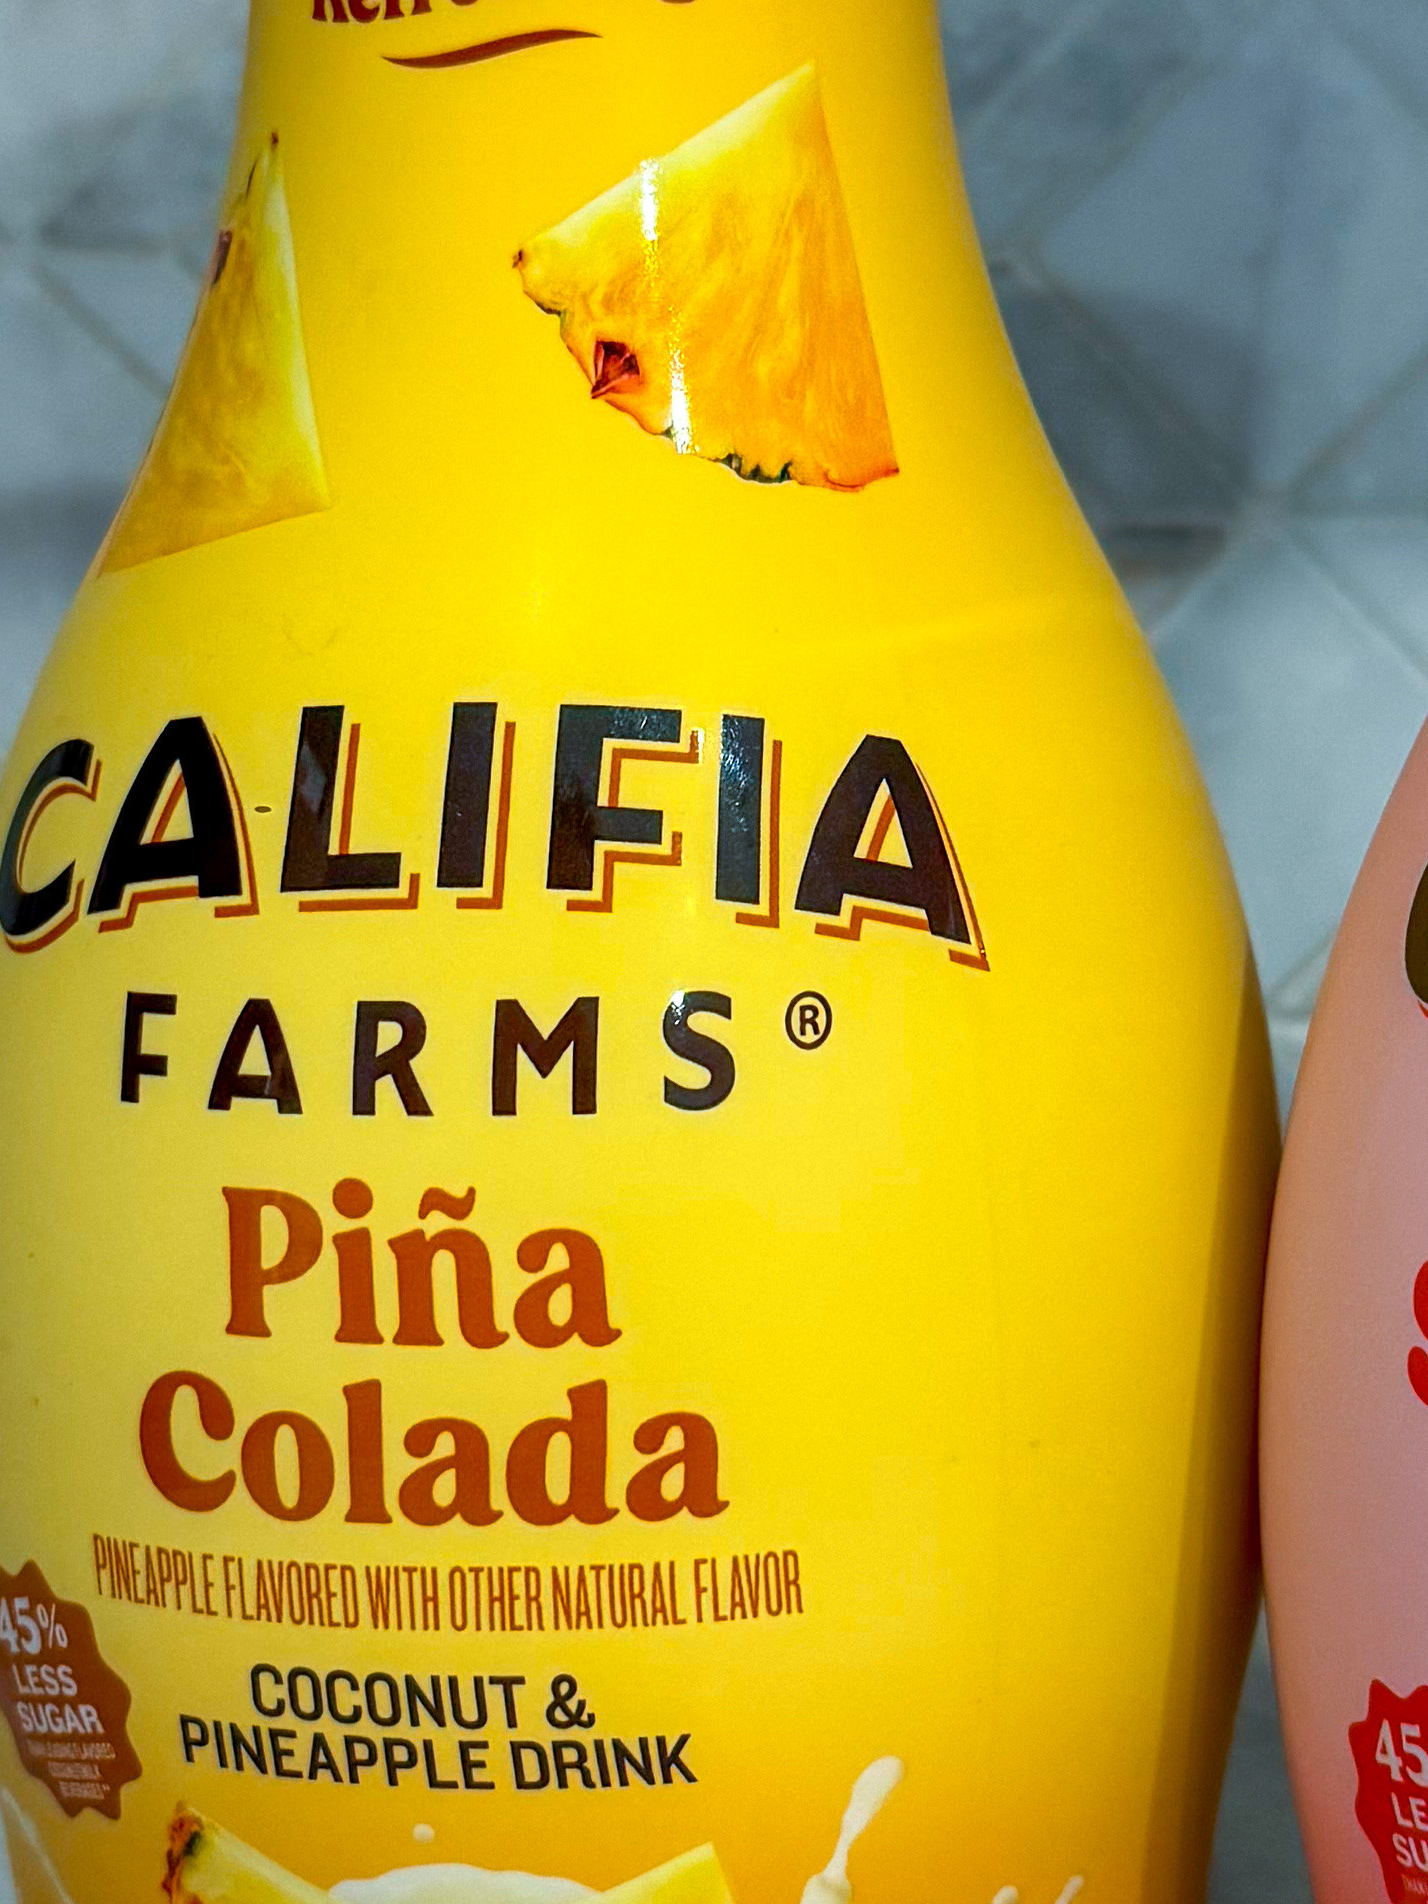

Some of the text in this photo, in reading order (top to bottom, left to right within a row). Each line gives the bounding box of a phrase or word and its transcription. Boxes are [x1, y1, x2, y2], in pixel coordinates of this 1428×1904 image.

[223, 1177, 622, 1350] Piña
[139, 1370, 730, 1527] Colada
[92, 1532, 804, 1632] PINEAPPLE FLAVORED WITH OTHER NATURAL FLAVOR
[12, 1663, 78, 1697] LESS
[16, 1701, 106, 1735] SUGAR
[250, 1662, 596, 1730] COCONUT &
[179, 1713, 698, 1790] PINEAPPLE DRINK
